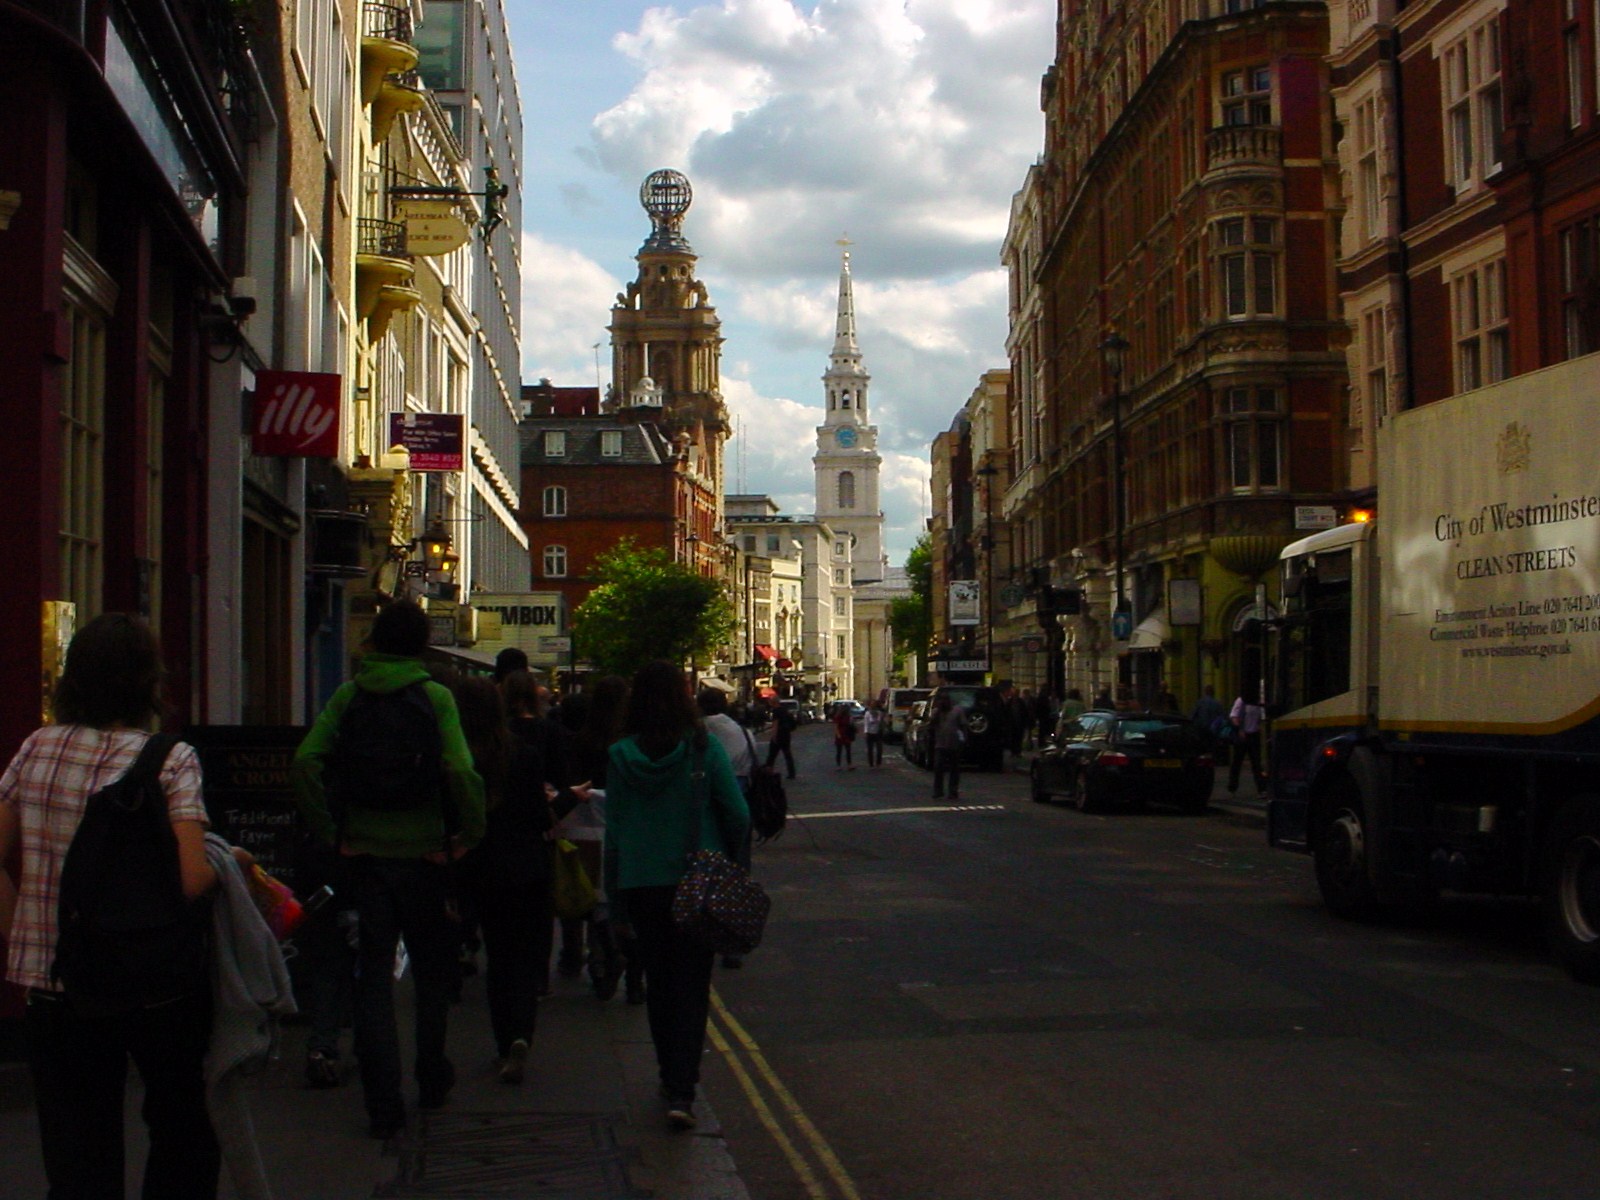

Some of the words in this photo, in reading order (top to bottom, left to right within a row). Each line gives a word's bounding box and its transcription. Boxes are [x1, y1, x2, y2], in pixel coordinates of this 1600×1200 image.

[259, 384, 336, 448] illy
[1434, 514, 1465, 547] City
[1468, 505, 1487, 537] of
[1457, 555, 1504, 580] CLEAN
[1507, 545, 1576, 575] STREETS
[475, 606, 556, 625] MBOX
[1518, 601, 1542, 616] Line
